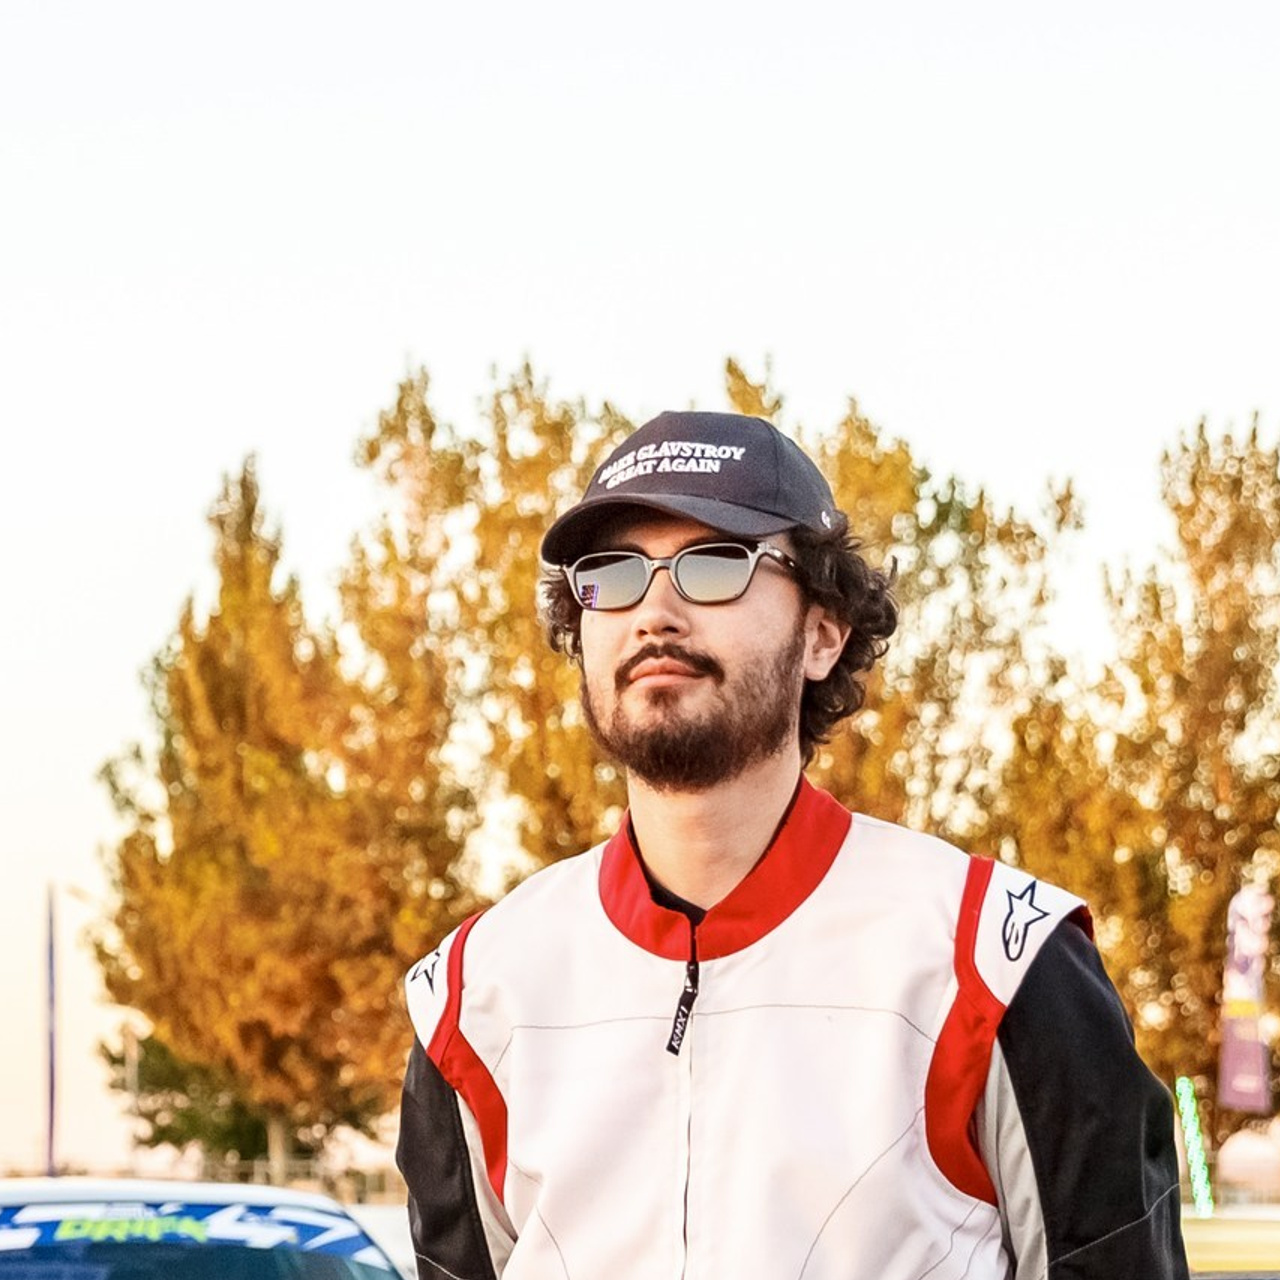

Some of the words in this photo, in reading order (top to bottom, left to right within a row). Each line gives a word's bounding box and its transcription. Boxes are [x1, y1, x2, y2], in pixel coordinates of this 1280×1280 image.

[636, 440, 746, 461] GLAVSTROY
[605, 460, 658, 490] GREAT
[656, 457, 721, 473] AGAIN
